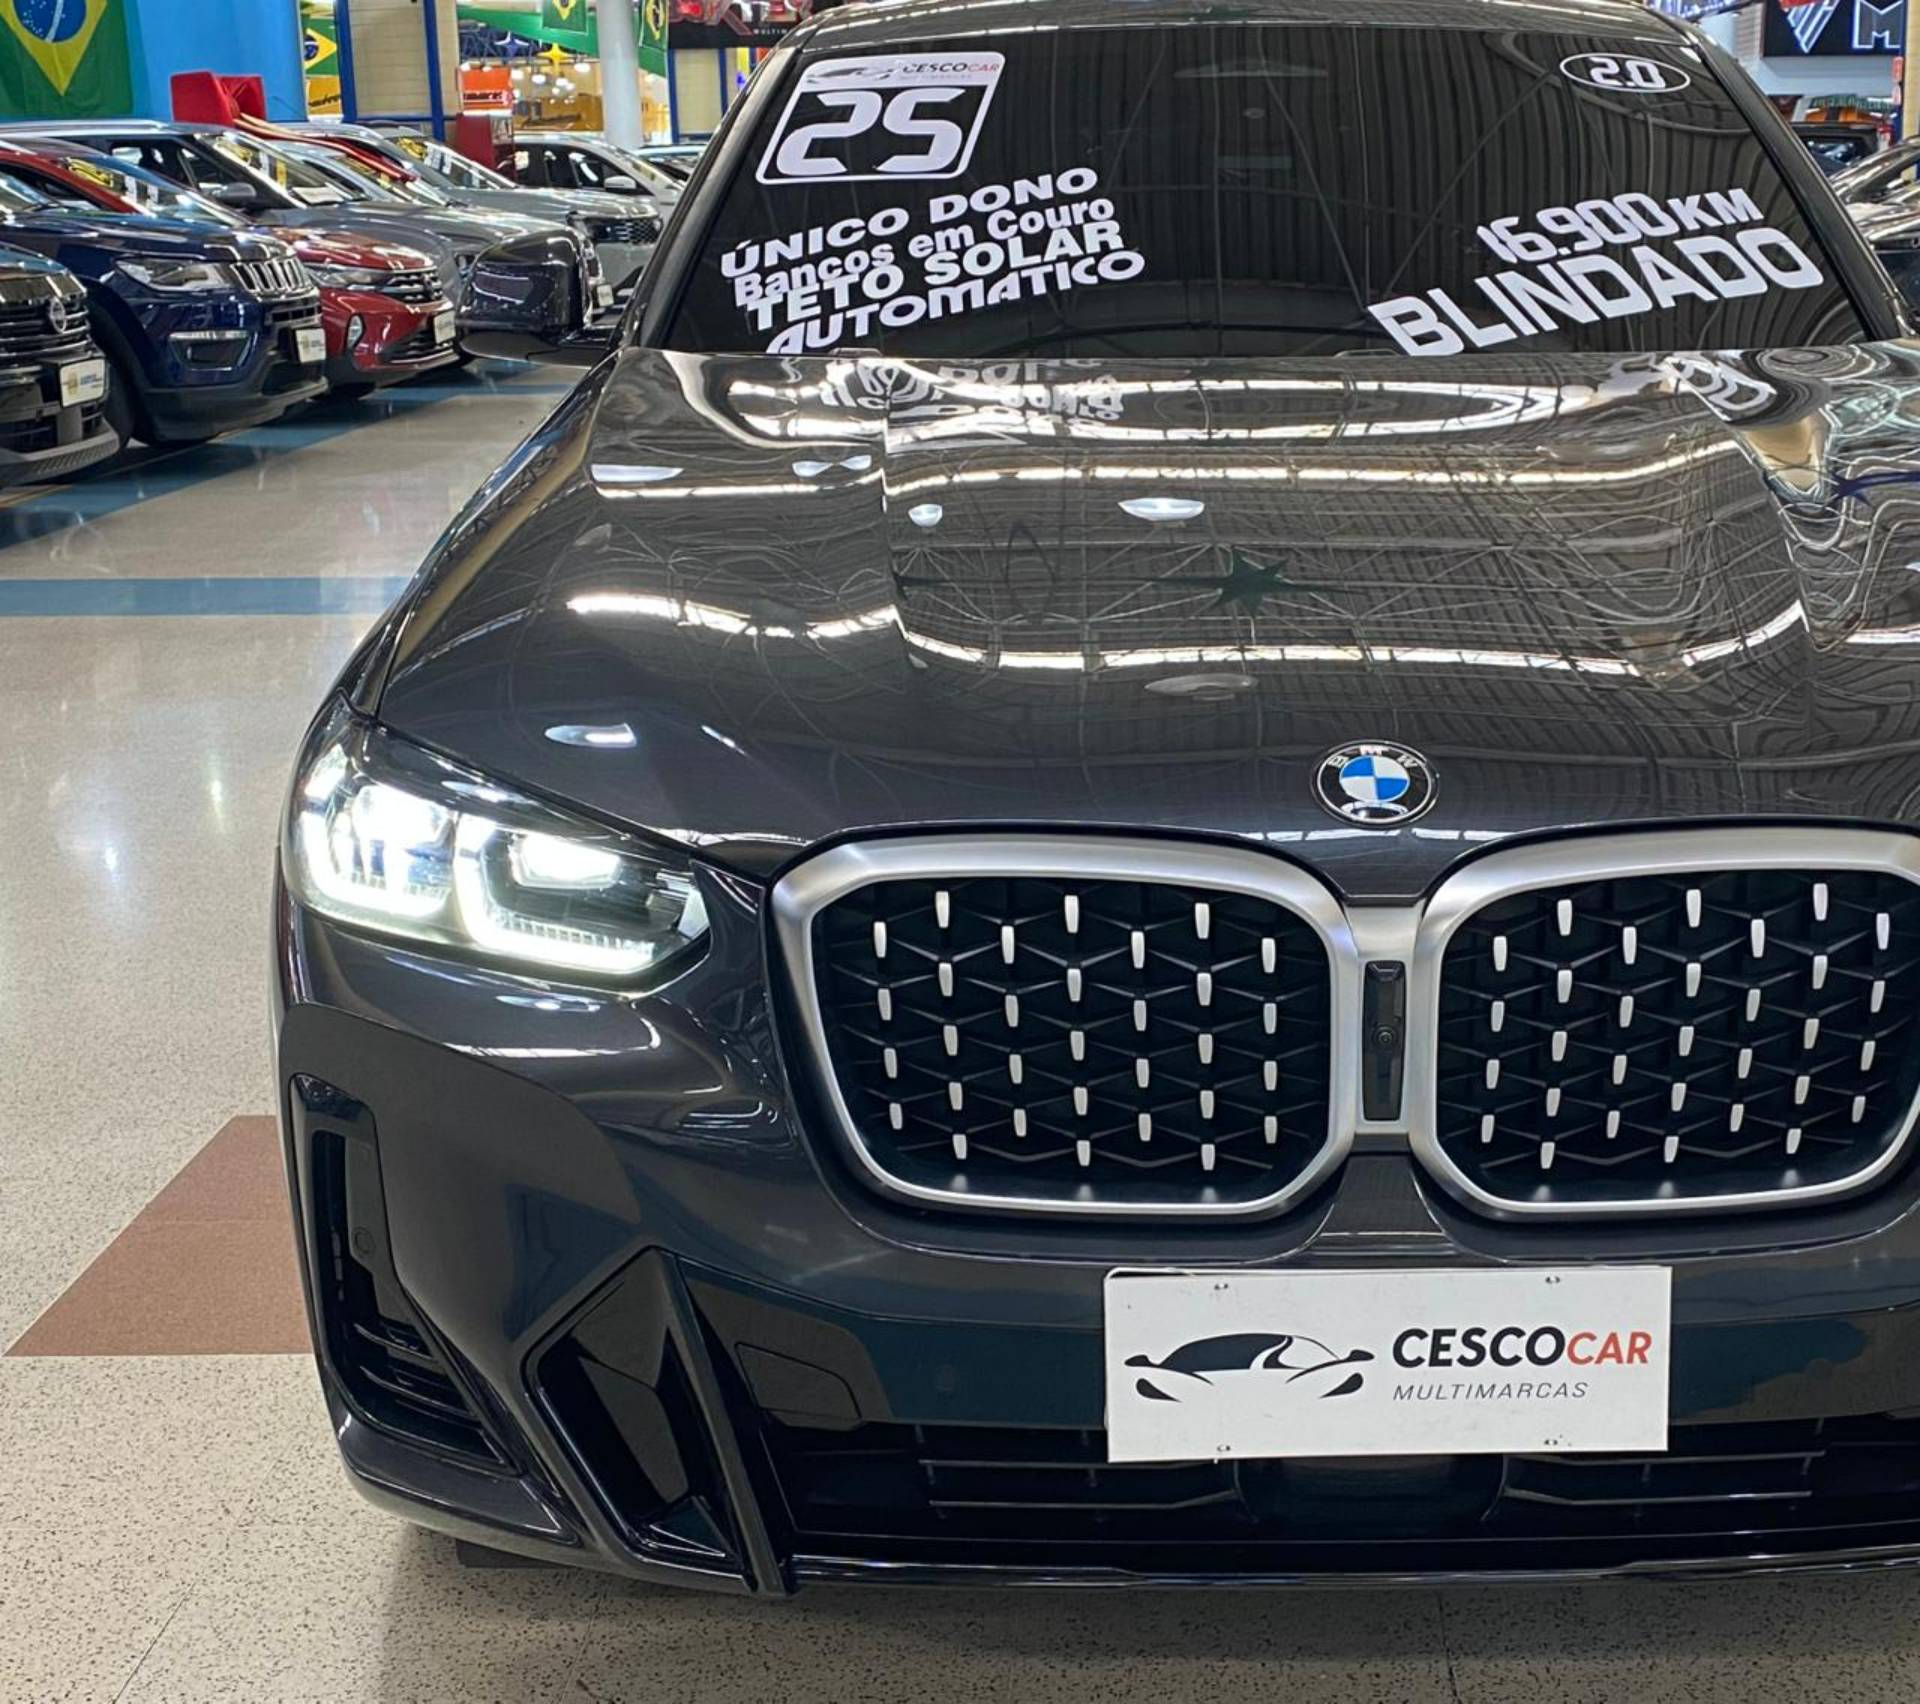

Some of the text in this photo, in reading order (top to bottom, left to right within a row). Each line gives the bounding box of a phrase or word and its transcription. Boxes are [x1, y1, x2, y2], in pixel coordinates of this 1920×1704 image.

[902, 62, 1000, 74] CESCOCAR
[1589, 56, 1666, 88] 2.0
[776, 88, 966, 176] 25
[721, 167, 1098, 278] ÚNICO DONO
[733, 198, 1115, 306] Bancos em Couro
[746, 220, 1125, 331] TETO SOLAR
[765, 250, 1146, 354] AUTOMATICO
[1367, 227, 1824, 356] BLINDADO
[1392, 1326, 1652, 1368] CESCOCAR
[1392, 1382, 1589, 1401] MULTIMARCAS
